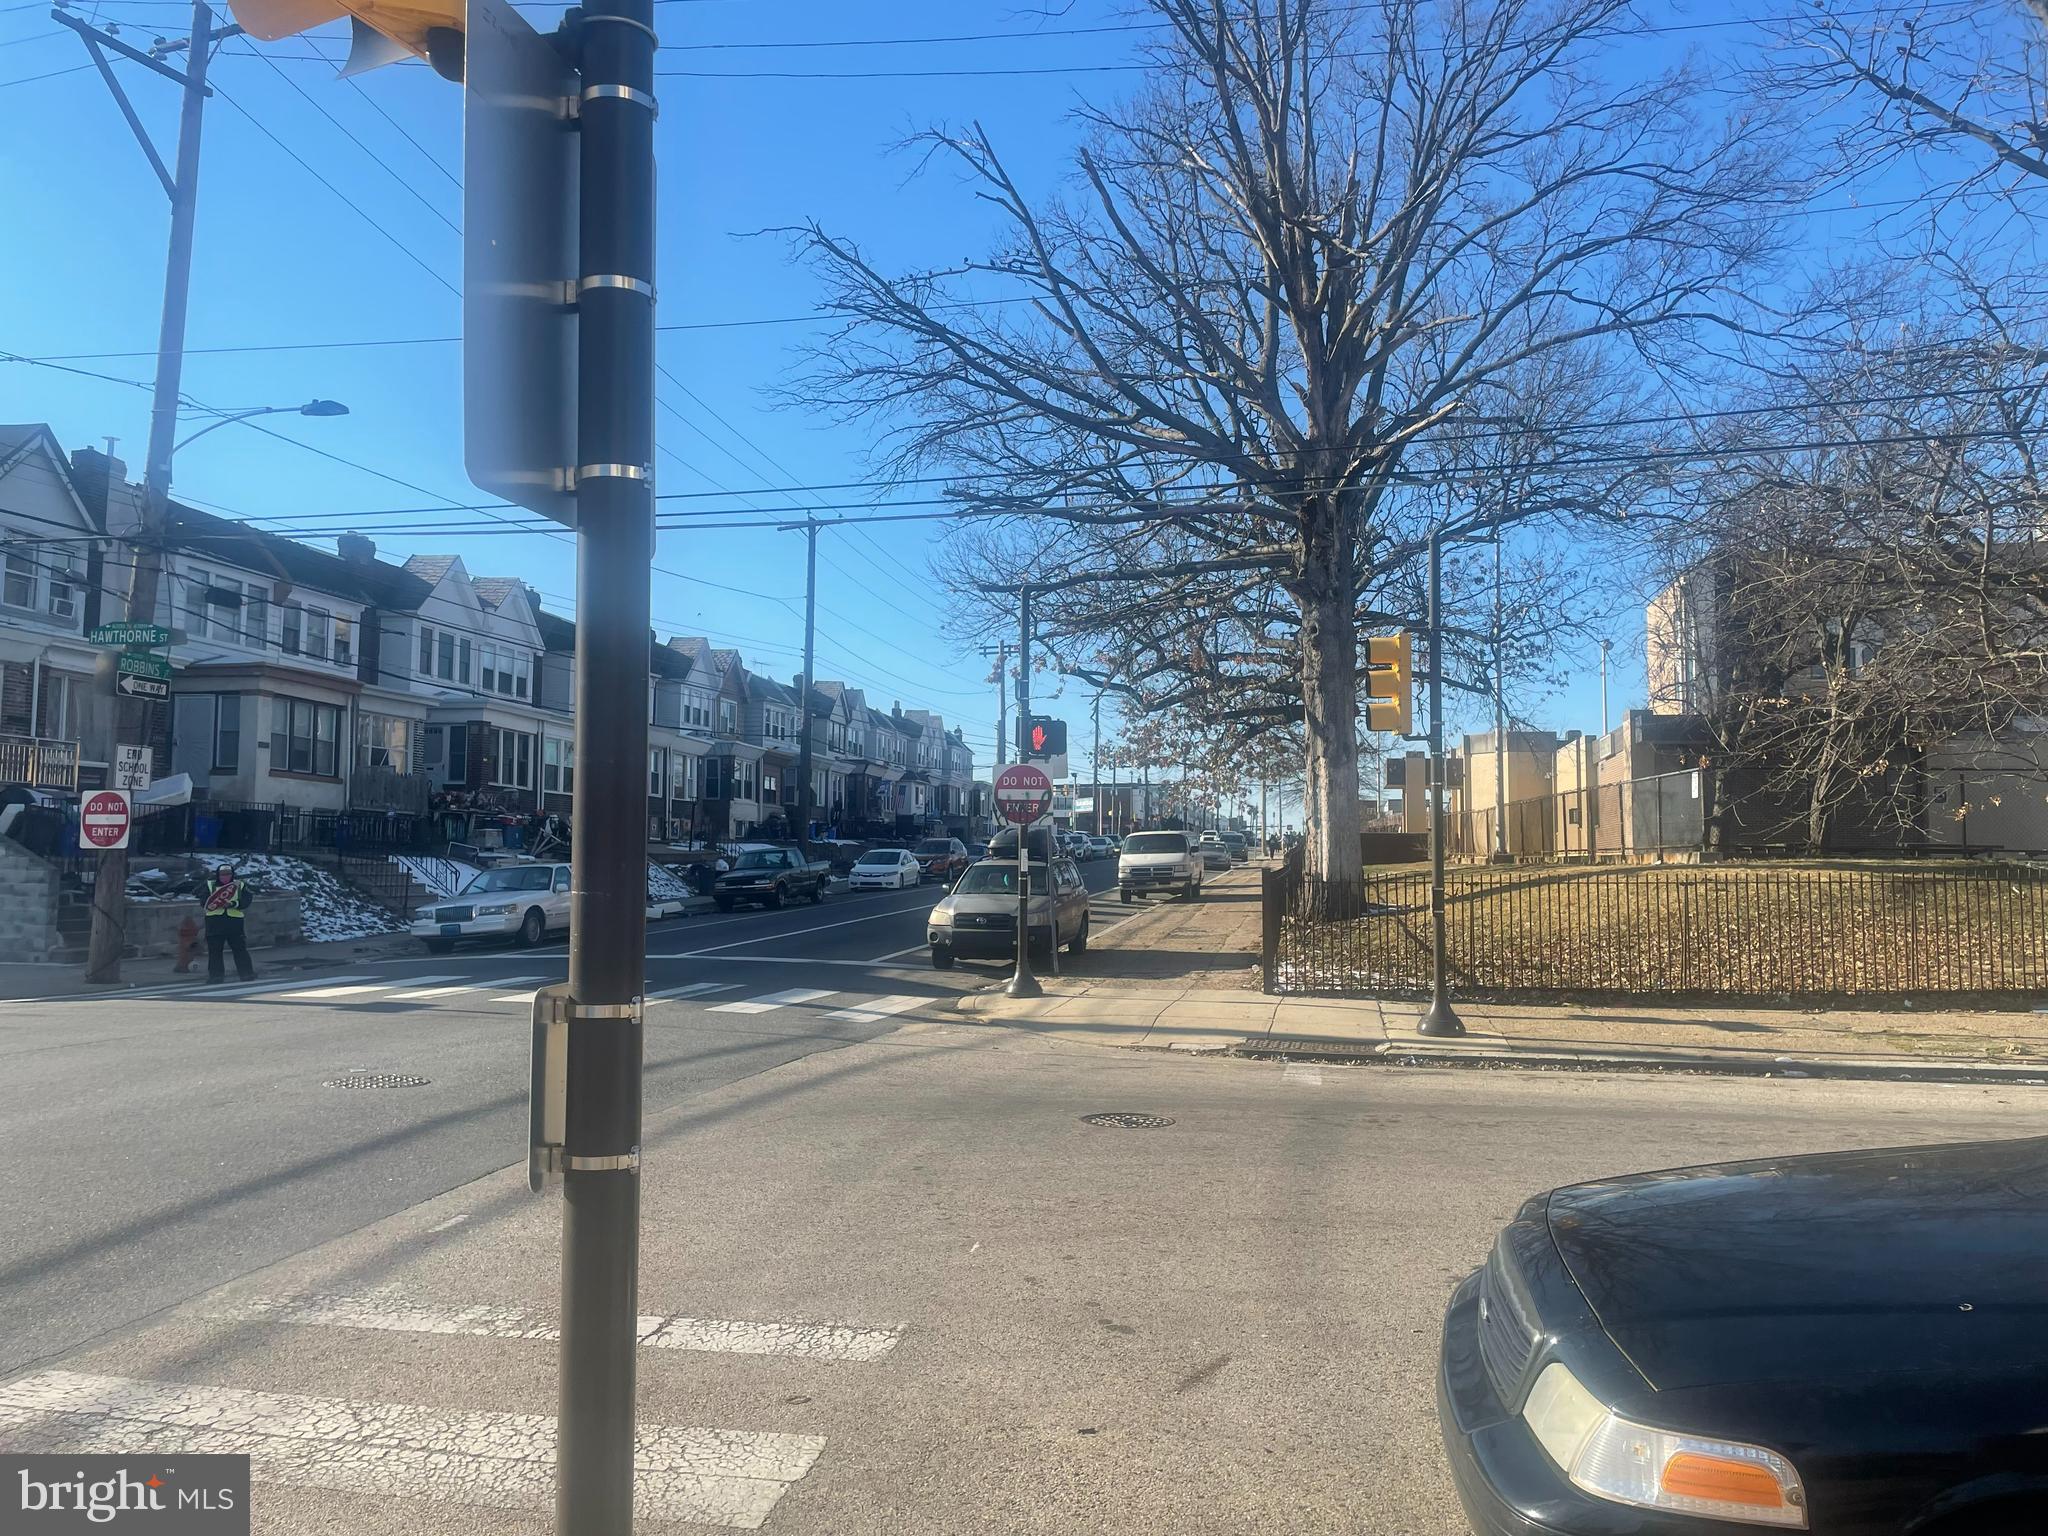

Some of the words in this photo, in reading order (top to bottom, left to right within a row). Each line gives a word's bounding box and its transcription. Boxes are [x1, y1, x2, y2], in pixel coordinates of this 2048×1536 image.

[90, 630, 157, 643] HAWTHORNE
[160, 633, 168, 642] ST
[120, 658, 160, 676] ROBBINS
[133, 681, 148, 692] ONE
[150, 684, 165, 694] WAY
[127, 749, 142, 760] END
[118, 761, 149, 774] SCHOOL
[122, 775, 143, 787] ZONE
[1003, 777, 1017, 786] DO
[1023, 777, 1044, 786] NOT
[90, 802, 103, 811] DO
[107, 802, 124, 811] NOT
[1006, 803, 1039, 813] ENER
[92, 827, 119, 837] ENTER
